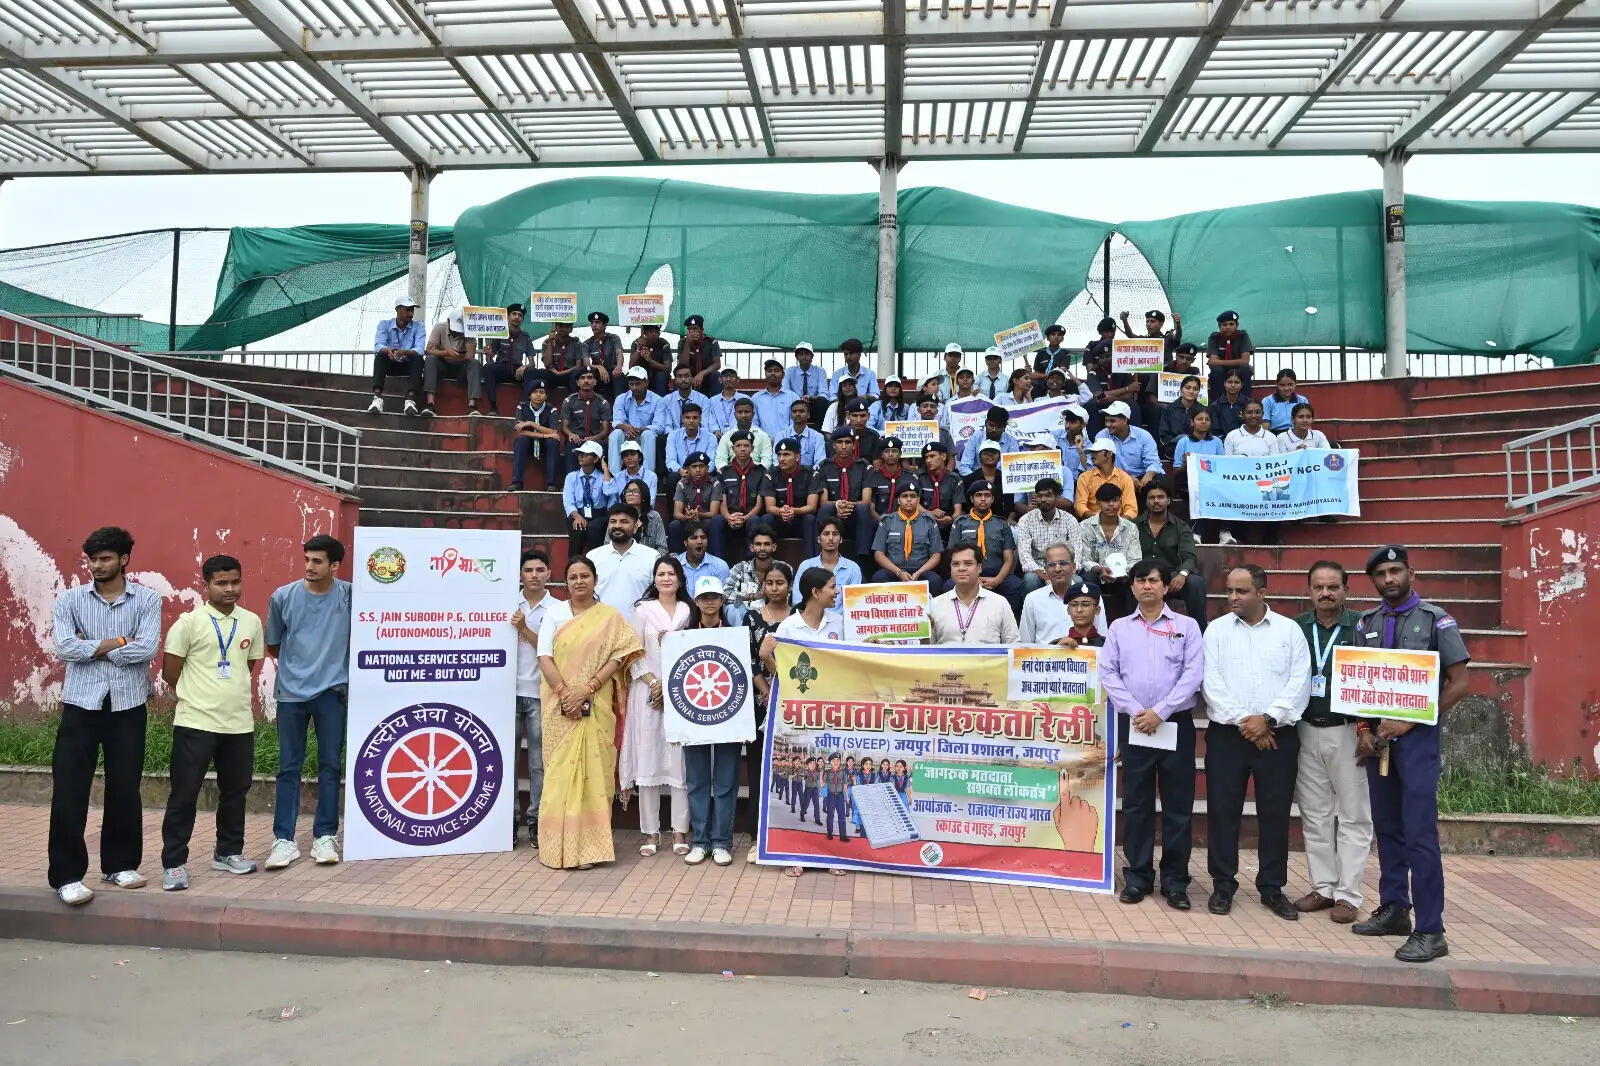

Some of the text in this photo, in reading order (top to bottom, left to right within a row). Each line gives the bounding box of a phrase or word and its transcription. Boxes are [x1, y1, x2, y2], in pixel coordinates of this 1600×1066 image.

[1255, 460, 1288, 470] 3 RAJ
[1266, 468, 1294, 478] UNIT
[1297, 464, 1321, 475] NCC
[865, 591, 908, 605] लोकतंत्र का
[359, 612, 508, 624] S.S. JAIN SUBODH P.G. COLLEGE
[850, 605, 925, 620] भाग्य विधाता होता है
[376, 627, 492, 640] (AUTONOMOUS), JAIPUR
[890, 623, 920, 634] मतदाता
[364, 654, 500, 666] NATIONAL SERVICE SCHEME
[697, 648, 716, 659] सेवा
[719, 652, 742, 675] योजना
[1022, 657, 1088, 673] बनो देश के भाग्य विधाता
[388, 669, 408, 680] NOT
[410, 669, 426, 680] ME
[435, 668, 455, 680] BUT
[456, 668, 477, 679] YOU
[1340, 662, 1429, 685] युवा हो तुम देश की शान
[1022, 680, 1032, 693] अब
[1033, 677, 1048, 694] जागो
[1049, 676, 1062, 694] प्यारे
[672, 684, 745, 722] NATIONAL SERVICE SCHEME
[1340, 685, 1428, 710] जागो उठो करो मतदाता
[782, 700, 886, 731] मतदाता
[1032, 701, 1096, 744] रैली
[363, 704, 494, 759] राष्ट्रीय सेवा योजना
[814, 732, 1060, 764] स्वीप (SVEEP) जयपुर जिला प्रशासन, जयपुर
[970, 770, 1014, 784] मतदाता
[362, 780, 496, 838] NATIONAL SERVICE SCHEME
[912, 796, 952, 814] आयोजक
[968, 802, 1005, 819] राजस्थान
[1006, 806, 1028, 820] राज्य
[1030, 809, 1051, 822] भारत
[936, 819, 1026, 842] स्काउट व गाइड, जयपुर
